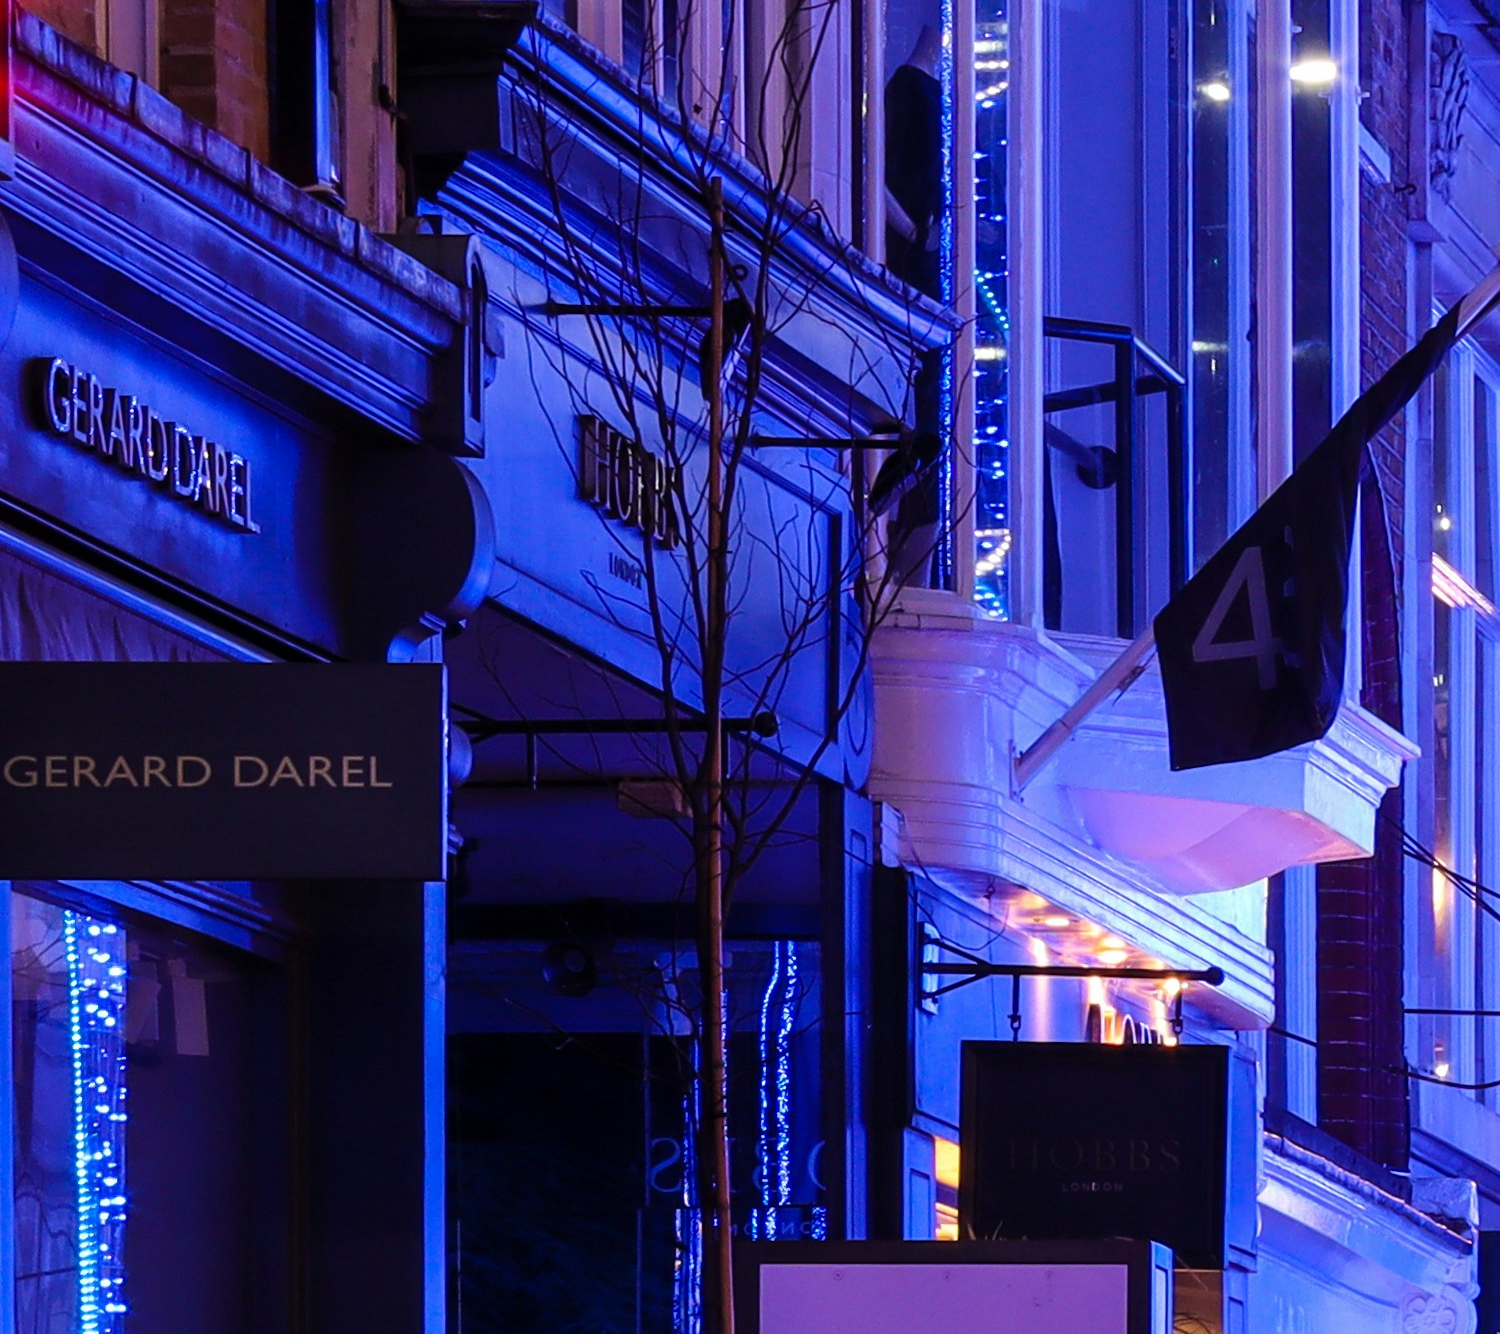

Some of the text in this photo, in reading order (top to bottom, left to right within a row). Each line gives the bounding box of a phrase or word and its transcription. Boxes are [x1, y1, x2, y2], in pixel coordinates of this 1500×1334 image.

[48, 357, 262, 534] GERARD DAREL
[3, 755, 393, 788] GERARD DAREL
[1010, 1138, 1181, 1172] HOBBS
[1062, 1182, 1123, 1192] LONDON
